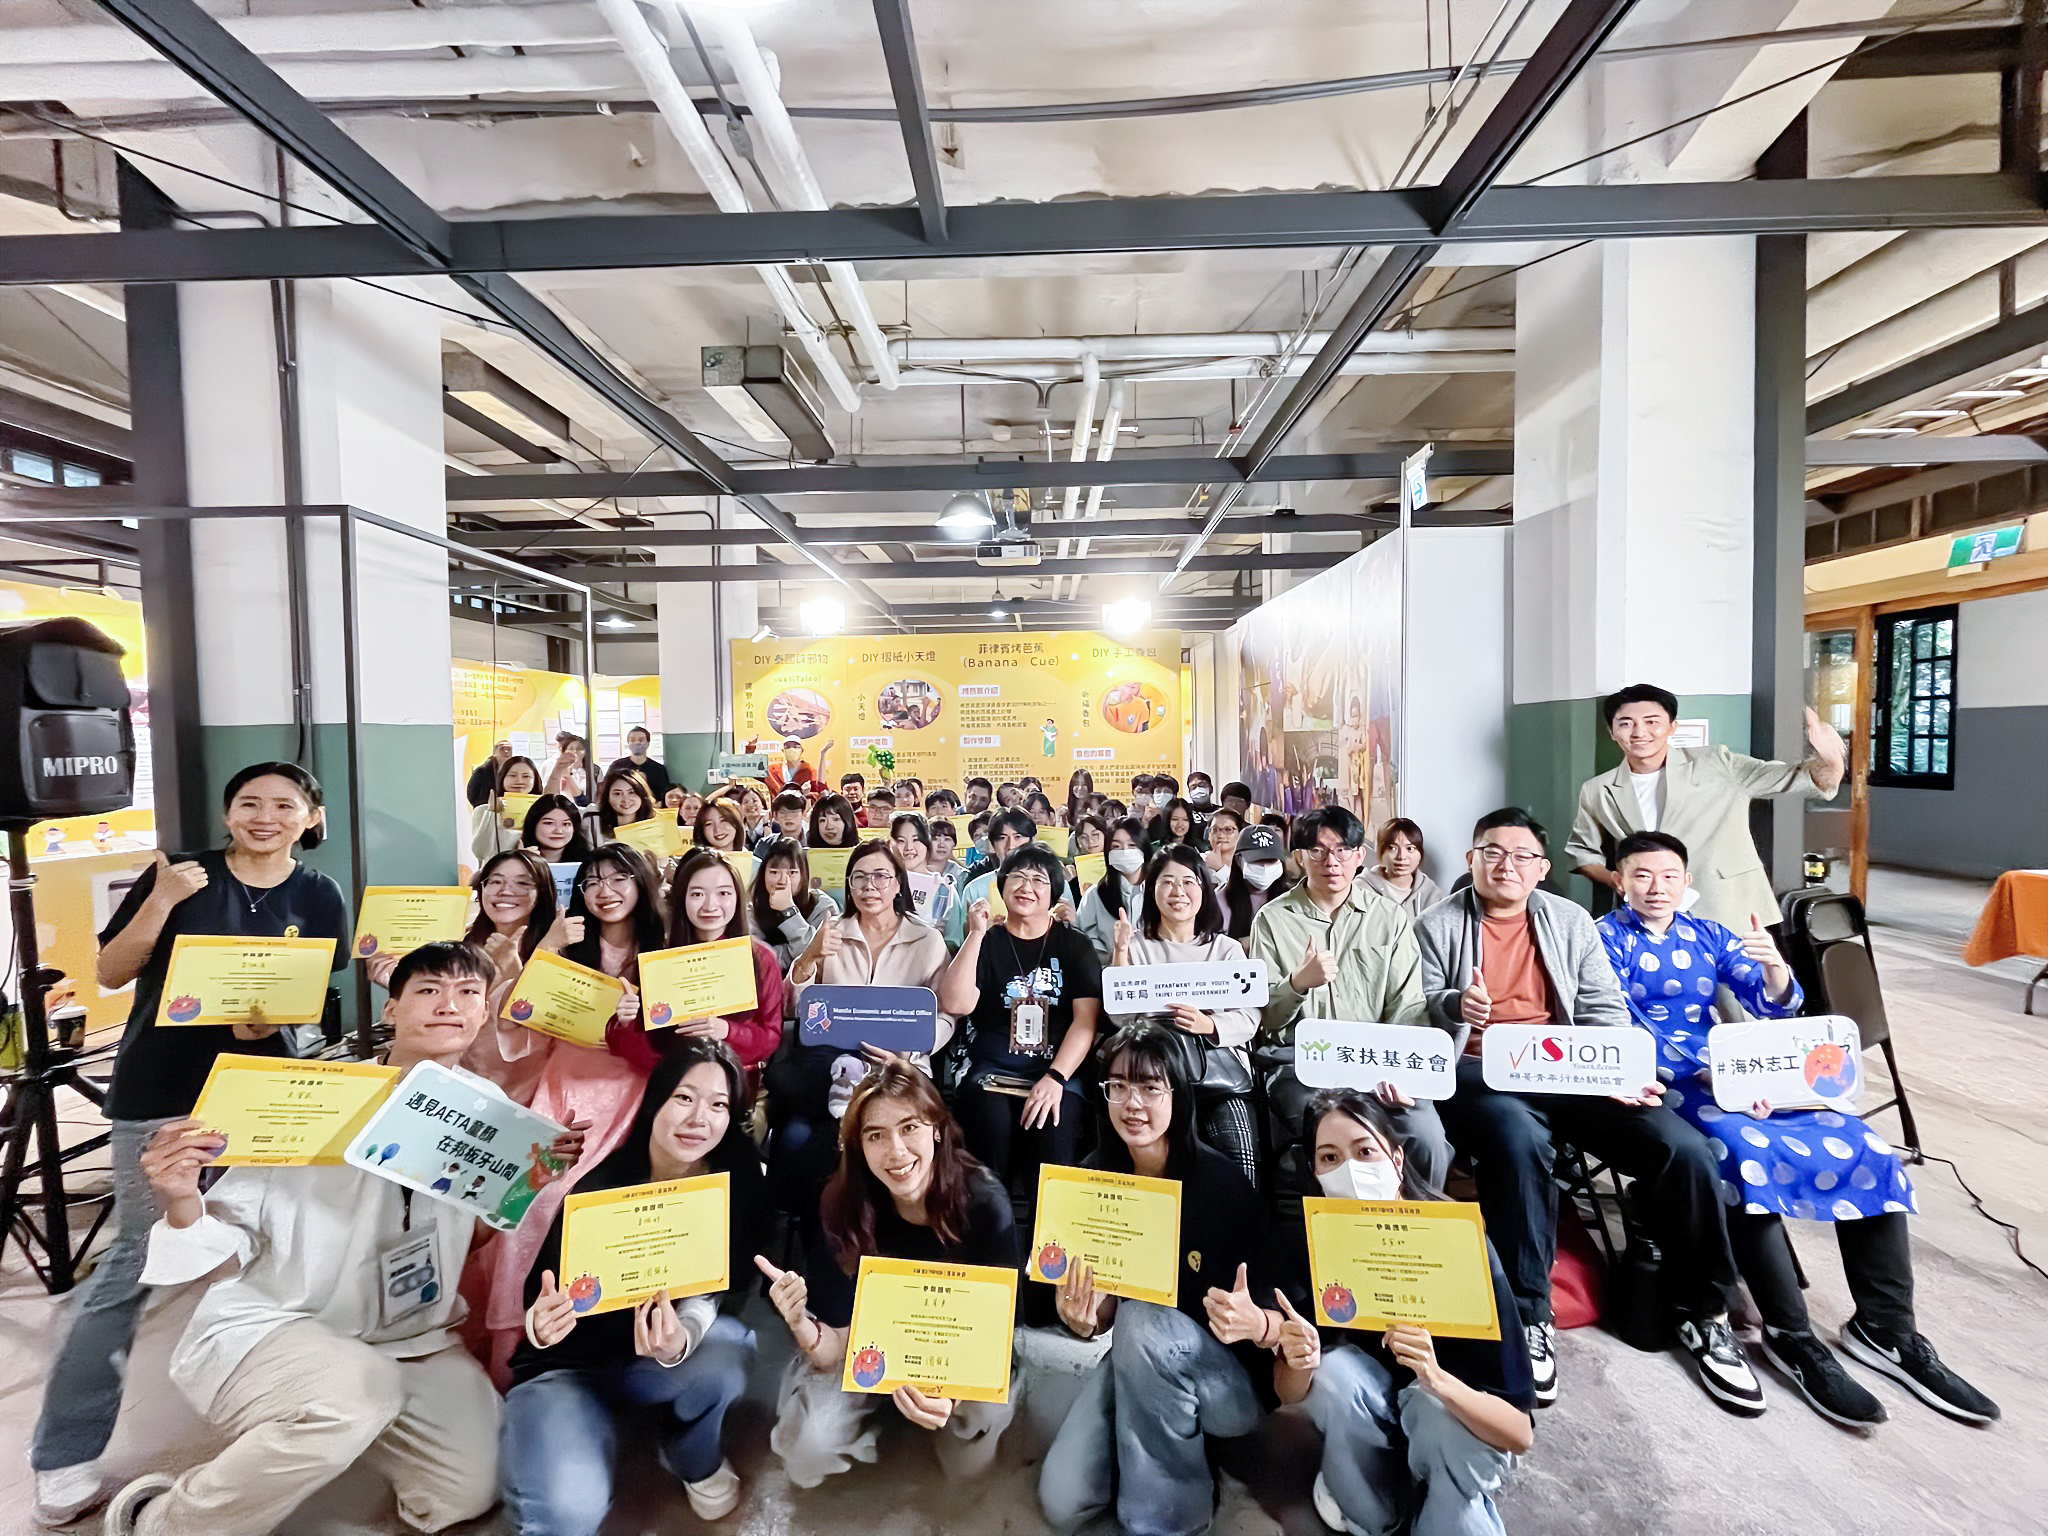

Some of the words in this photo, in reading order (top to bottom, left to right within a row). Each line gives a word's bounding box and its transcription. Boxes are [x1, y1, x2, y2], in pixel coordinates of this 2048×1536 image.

[862, 653, 879, 662] DIY
[1092, 648, 1109, 657] DIY
[754, 655, 771, 664] DIY
[963, 657, 1018, 668] (Banana
[1030, 656, 1059, 666] Cue)
[42, 756, 118, 777] MIPRO
[1154, 982, 1191, 990] DEPARTMENT
[1113, 990, 1149, 1001] 青年局
[1336, 1046, 1448, 1073] 家扶基金會
[1717, 1055, 1800, 1076] #海外志工
[405, 1091, 499, 1143] 遇見AETA童顏
[436, 1135, 520, 1181] 在邦板牙山間
